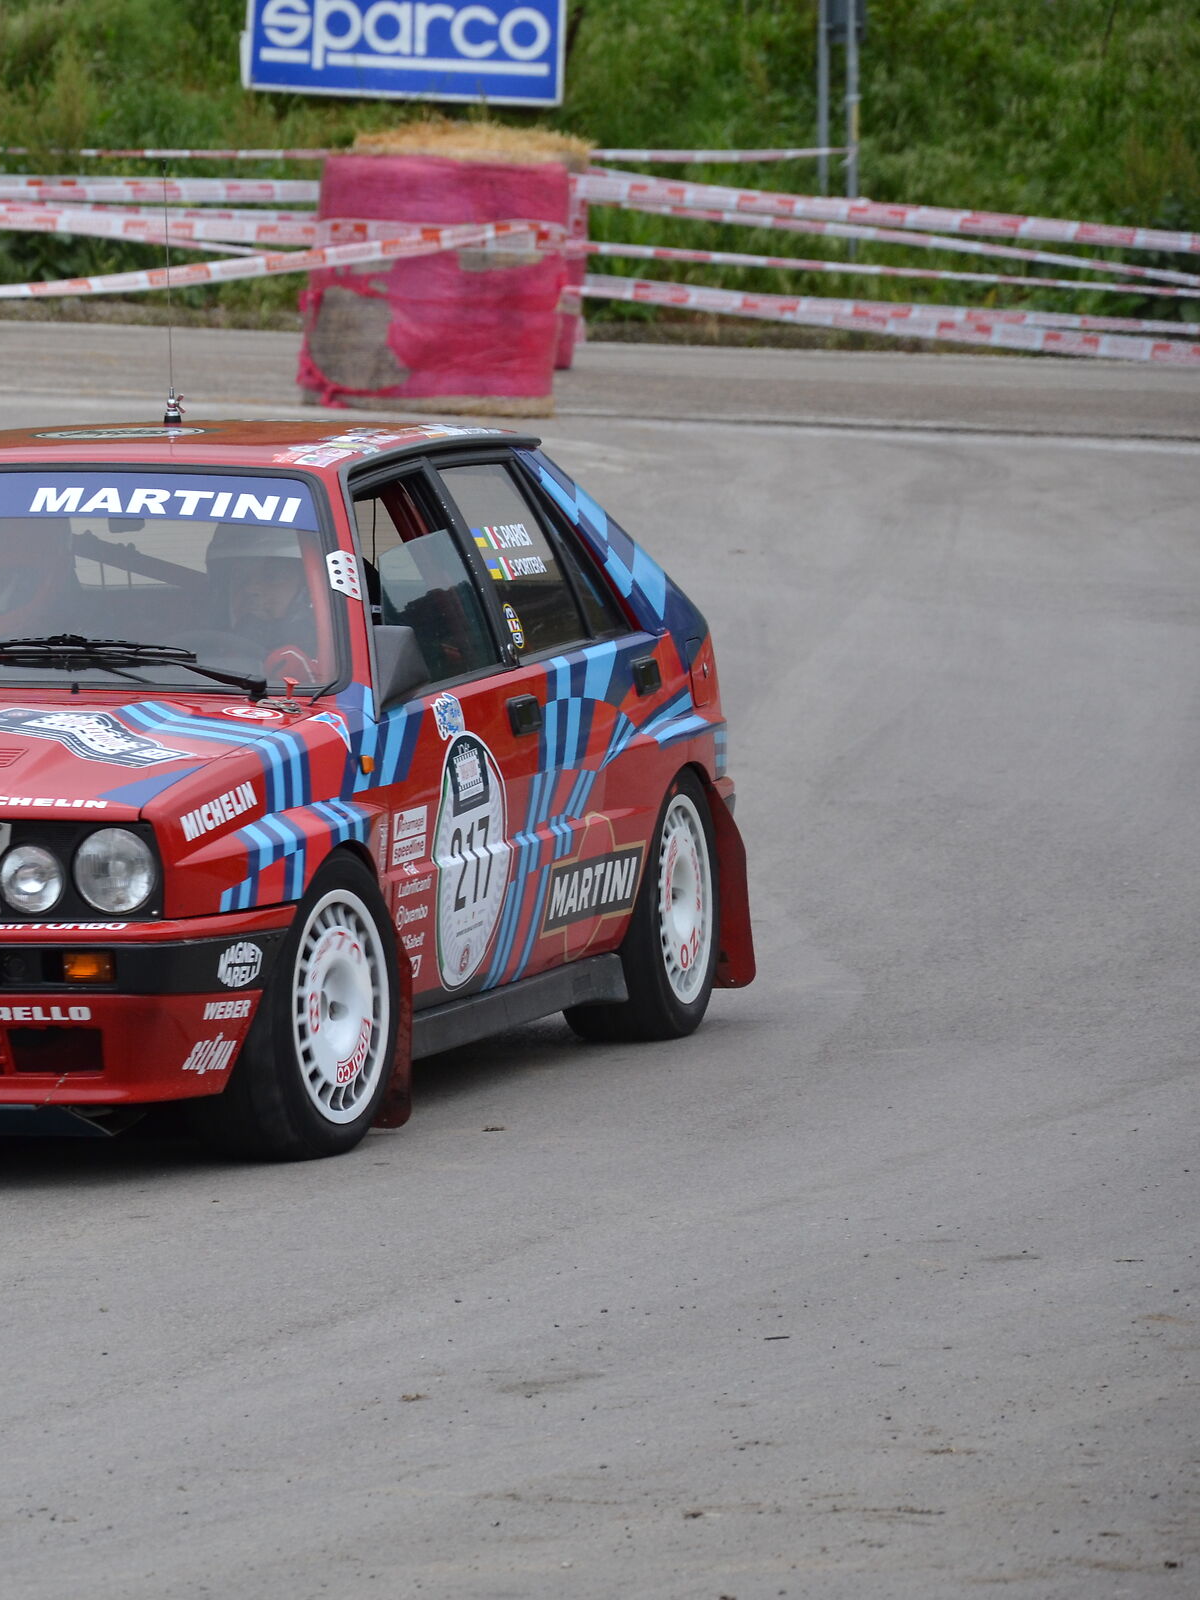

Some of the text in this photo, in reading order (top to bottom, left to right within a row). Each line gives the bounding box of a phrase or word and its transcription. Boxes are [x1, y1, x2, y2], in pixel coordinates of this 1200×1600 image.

[261, 0, 551, 70] sparco
[29, 486, 302, 523] MARTINI
[179, 780, 258, 842] MICHELIN
[451, 816, 492, 913] 217
[549, 856, 638, 921] MARTINI
[203, 999, 252, 1021] WEBER
